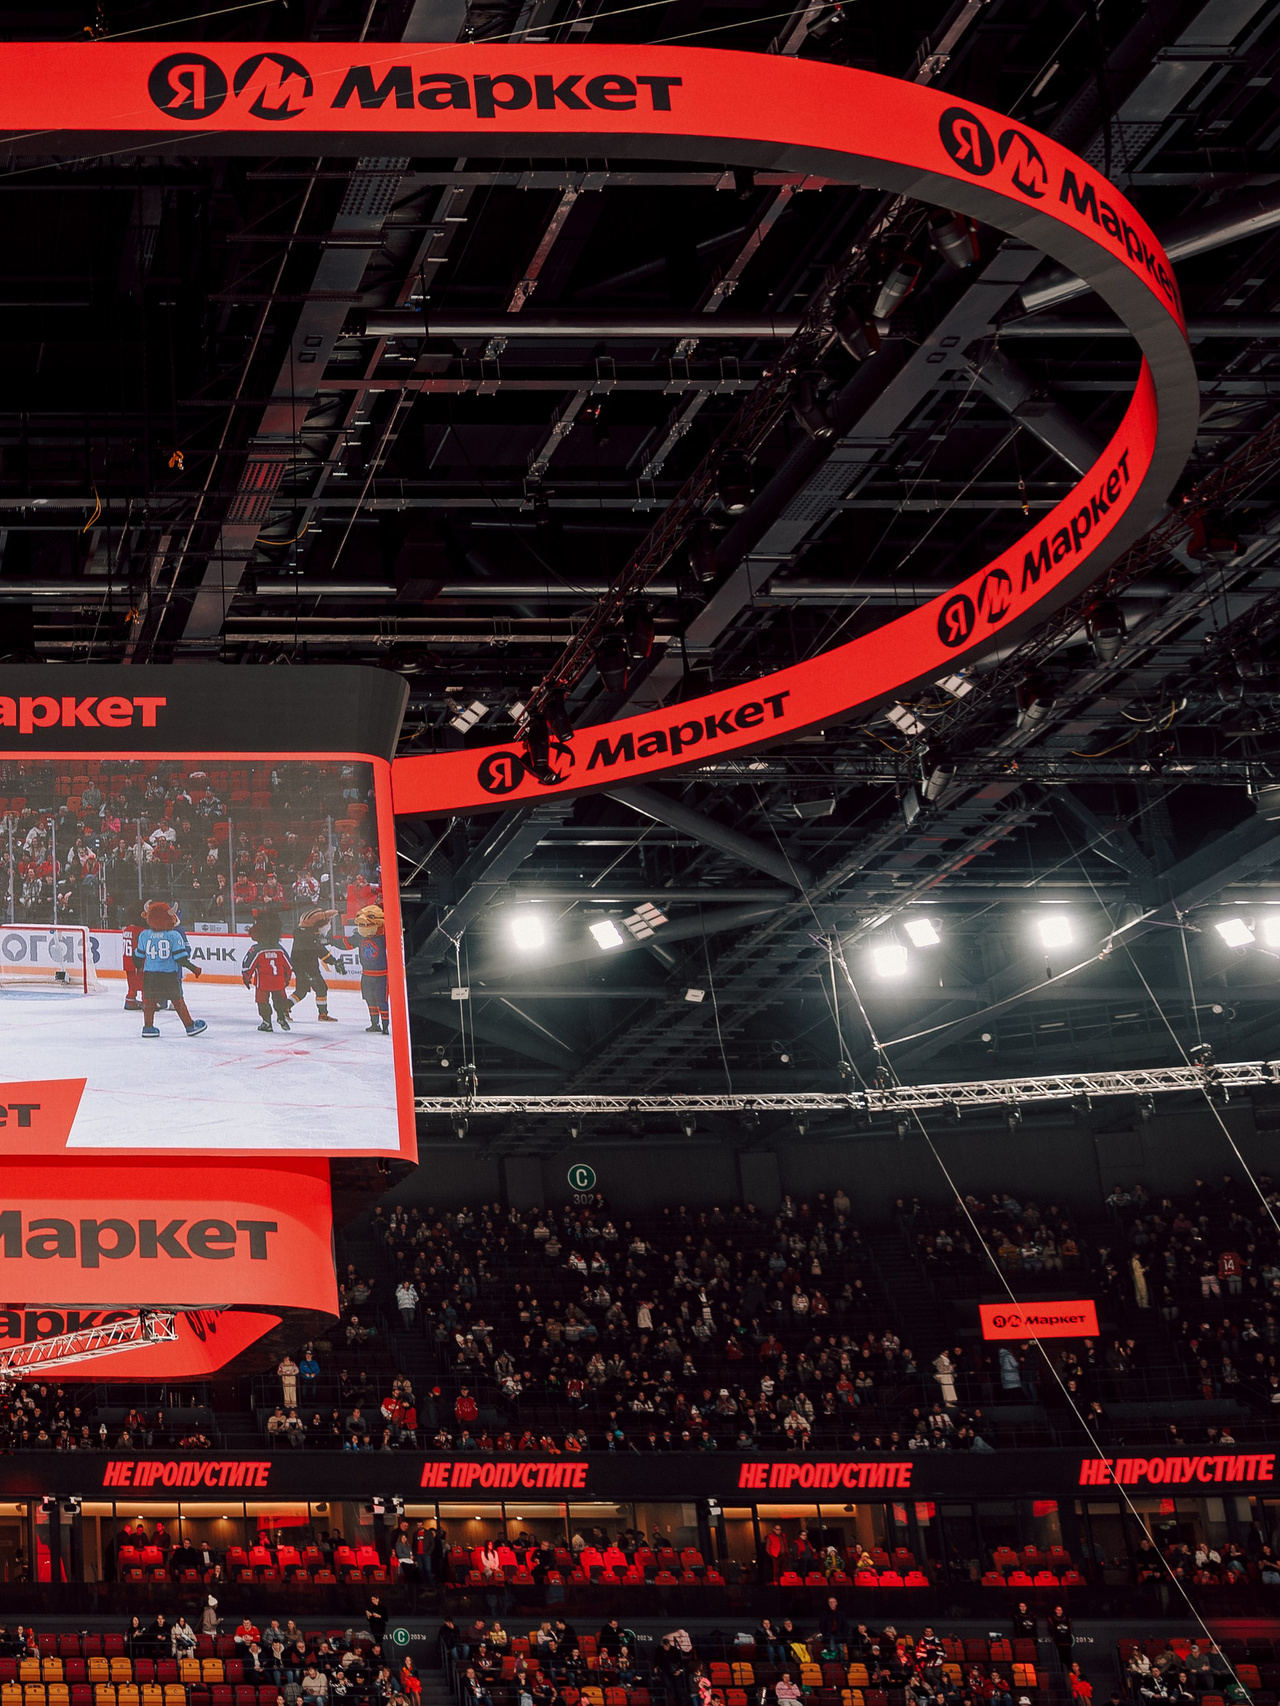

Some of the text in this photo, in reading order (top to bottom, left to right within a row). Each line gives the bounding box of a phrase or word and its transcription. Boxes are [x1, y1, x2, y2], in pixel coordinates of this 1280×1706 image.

[331, 65, 682, 118] Маркет
[1021, 448, 1130, 594] Маркет
[586, 690, 791, 772] Маркет
[146, 939, 170, 960] 48
[191, 946, 237, 962] АНК
[1223, 1259, 1235, 1270] 14
[1024, 1315, 1086, 1326] Маркет
[103, 1462, 271, 1487] НЕ ПРОПУСТИТЕ
[421, 1463, 589, 1488] НЕ ПРОПУСТИТЕ
[739, 1463, 913, 1488] НЕ ПРОПУСТИТЕ
[1079, 1453, 1276, 1485] НЕ ПРОПУСТИТЕ
